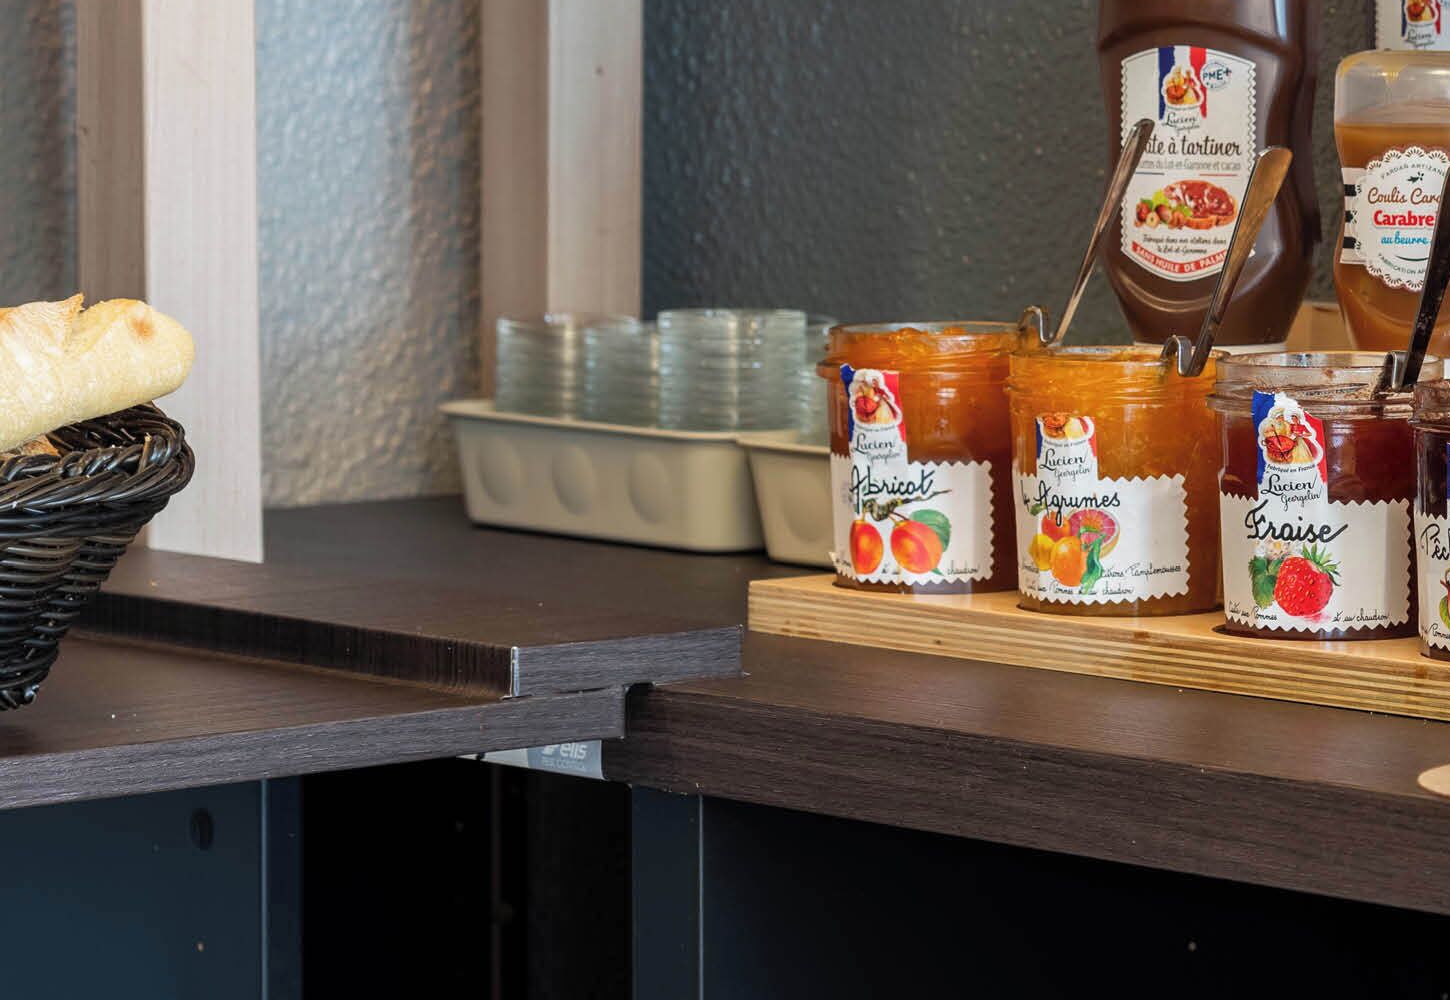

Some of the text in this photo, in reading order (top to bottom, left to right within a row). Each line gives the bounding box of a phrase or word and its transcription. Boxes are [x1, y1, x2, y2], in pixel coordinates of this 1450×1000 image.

[1167, 136, 1177, 154] à
[1180, 134, 1242, 156] tartiner
[1367, 186, 1408, 205] Coulis
[1373, 209, 1437, 227] Carabre
[1380, 230, 1430, 245] au beurre
[1135, 245, 1155, 263] SANS
[1154, 257, 1180, 273] HUILE
[1183, 263, 1196, 274] DE
[850, 432, 897, 455] Lucien
[1038, 447, 1088, 472] Lucien
[849, 465, 936, 515] Abricot
[1260, 473, 1318, 497] Lucien
[1033, 480, 1121, 527] Agrumes
[1280, 489, 1321, 512] Georgelin
[1244, 499, 1349, 544] Fraise
